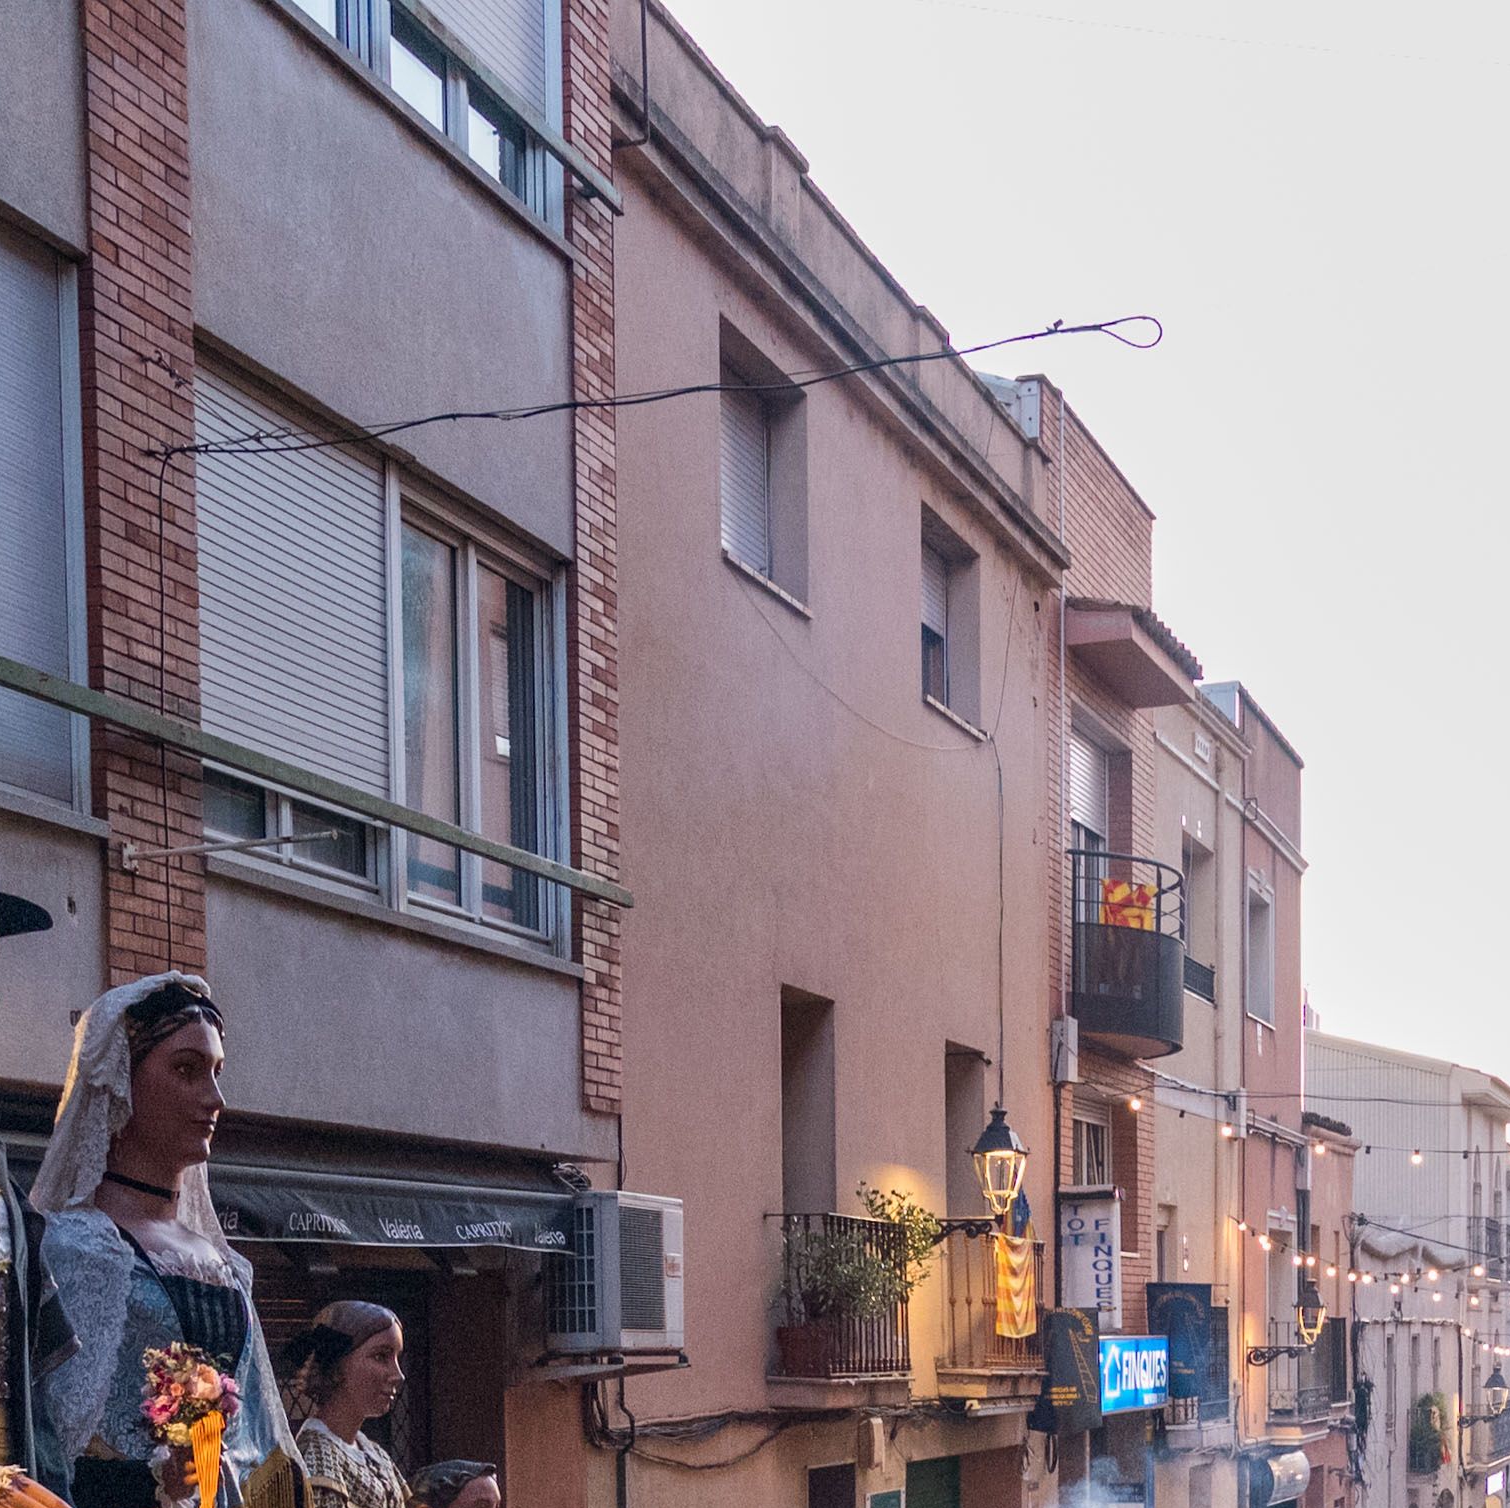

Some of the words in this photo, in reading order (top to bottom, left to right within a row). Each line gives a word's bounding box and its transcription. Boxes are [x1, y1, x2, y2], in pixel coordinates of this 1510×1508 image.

[378, 1217, 425, 1241] Valèria
[1066, 1203, 1085, 1246] TOT
[1122, 1350, 1167, 1391] FINQUES
